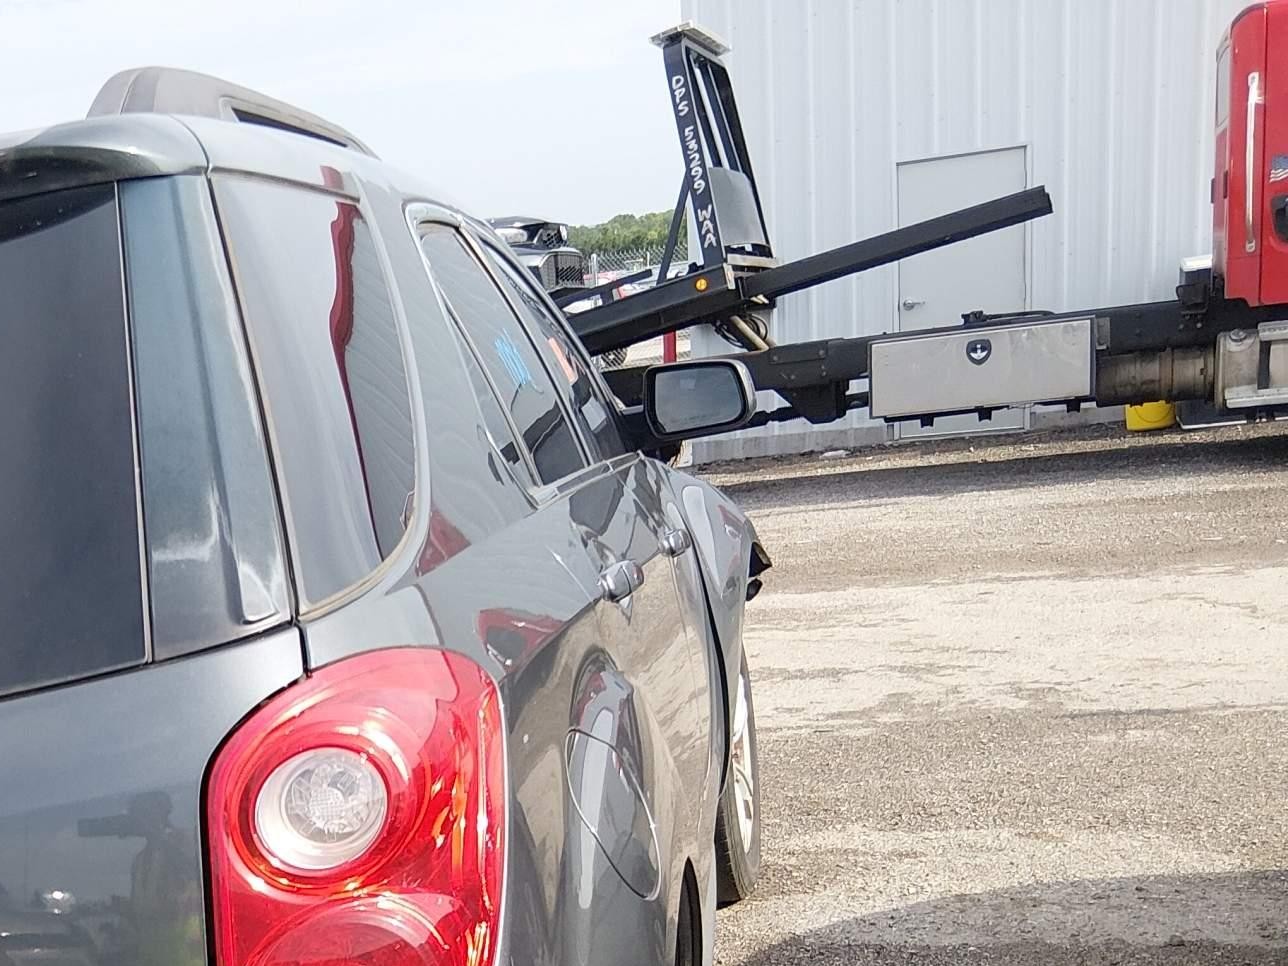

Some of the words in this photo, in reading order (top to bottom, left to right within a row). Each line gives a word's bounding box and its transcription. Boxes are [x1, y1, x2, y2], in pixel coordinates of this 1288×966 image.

[671, 75, 689, 116] DPS
[684, 125, 705, 194] 53299
[697, 204, 717, 249] WAA
